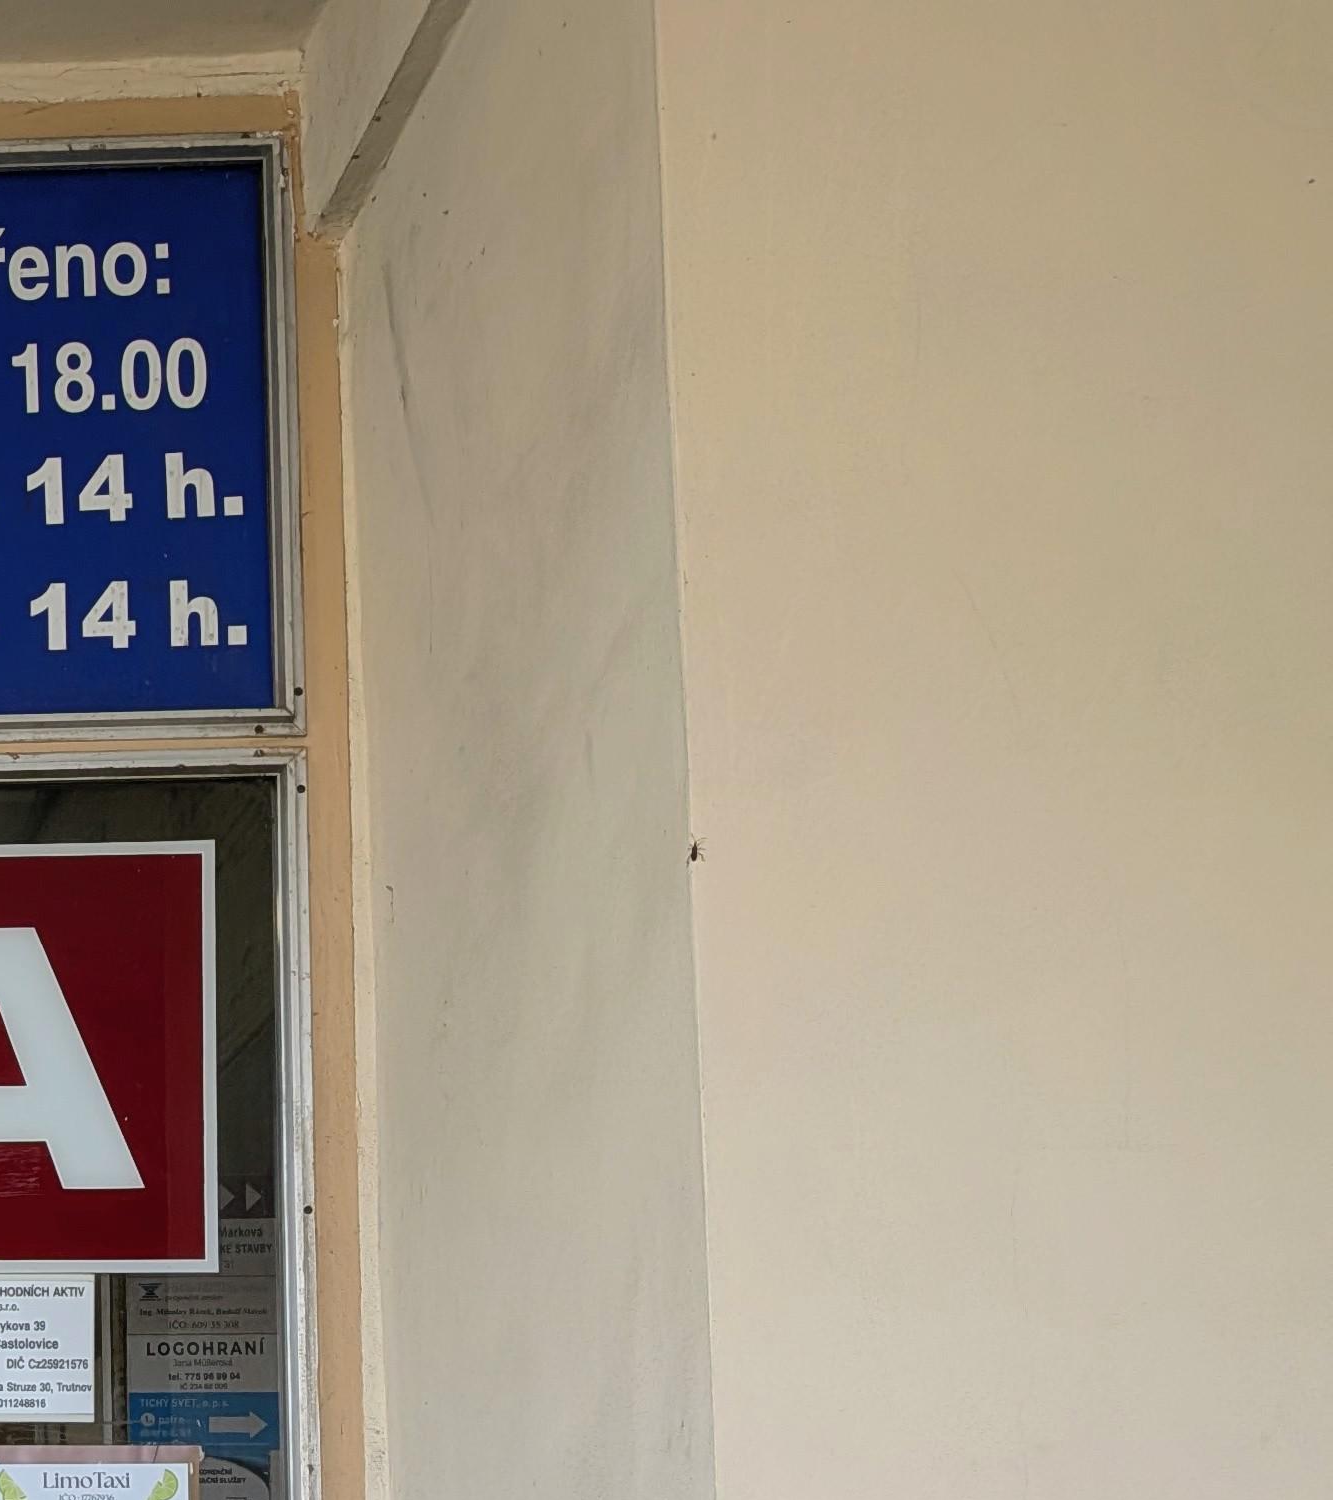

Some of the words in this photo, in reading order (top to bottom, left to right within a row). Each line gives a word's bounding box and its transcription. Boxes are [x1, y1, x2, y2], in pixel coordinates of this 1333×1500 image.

[11, 338, 208, 413] 18.00
[26, 454, 133, 525] 14
[165, 452, 243, 519] h.
[30, 580, 136, 651] 14
[169, 579, 248, 647] h.
[53, 1287, 85, 1297] AKTIV
[34, 1321, 45, 1331] 39
[146, 1337, 265, 1356] LOGOHRANÍ
[6, 1356, 25, 1369] DIČ
[57, 1383, 92, 1392] Trutnov
